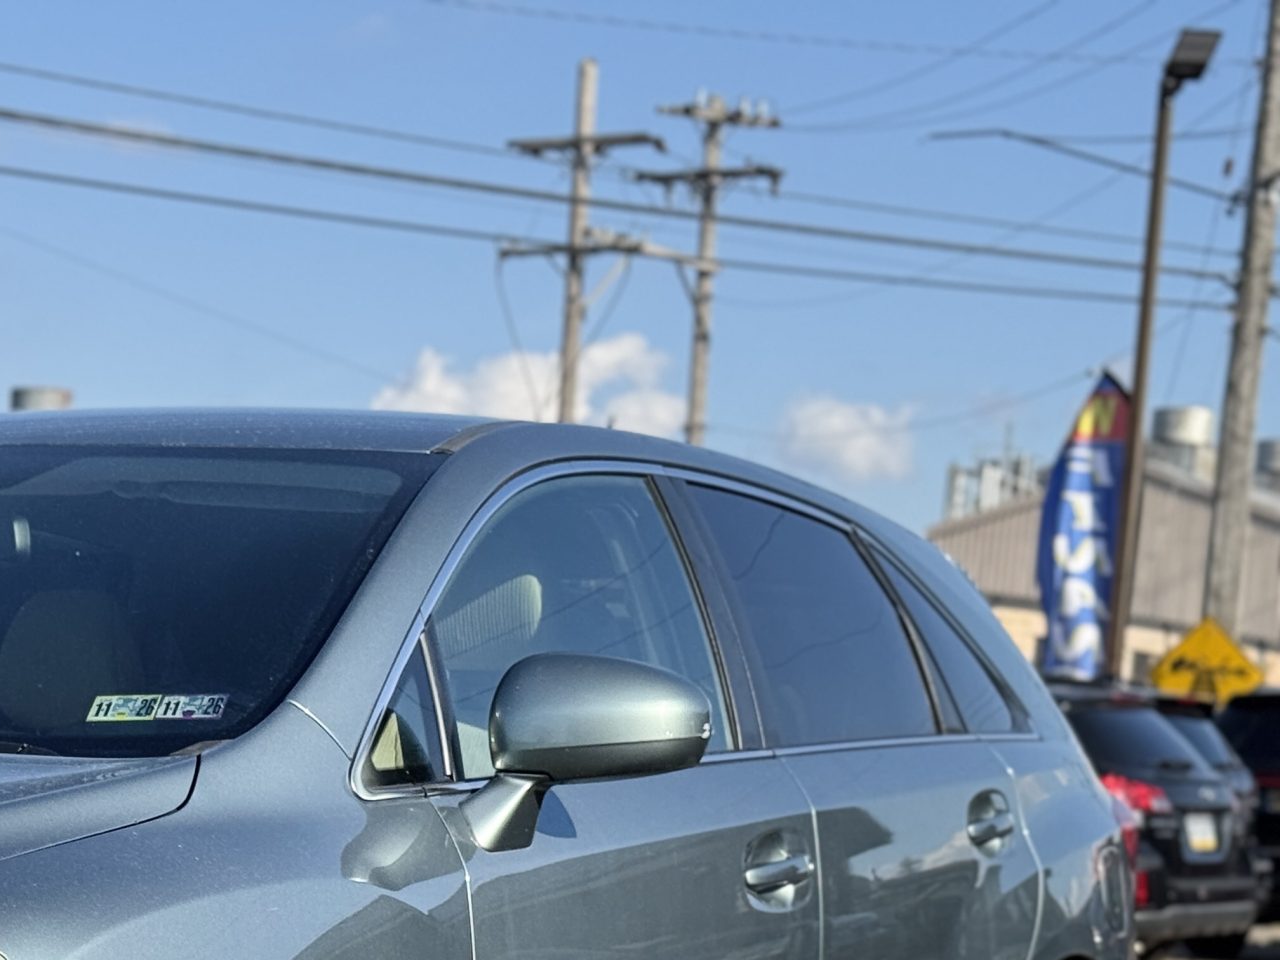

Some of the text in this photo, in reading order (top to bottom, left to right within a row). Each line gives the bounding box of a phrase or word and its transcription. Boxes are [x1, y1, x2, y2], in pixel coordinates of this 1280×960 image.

[95, 698, 156, 717] 11 26
[162, 697, 224, 716] 11 26
